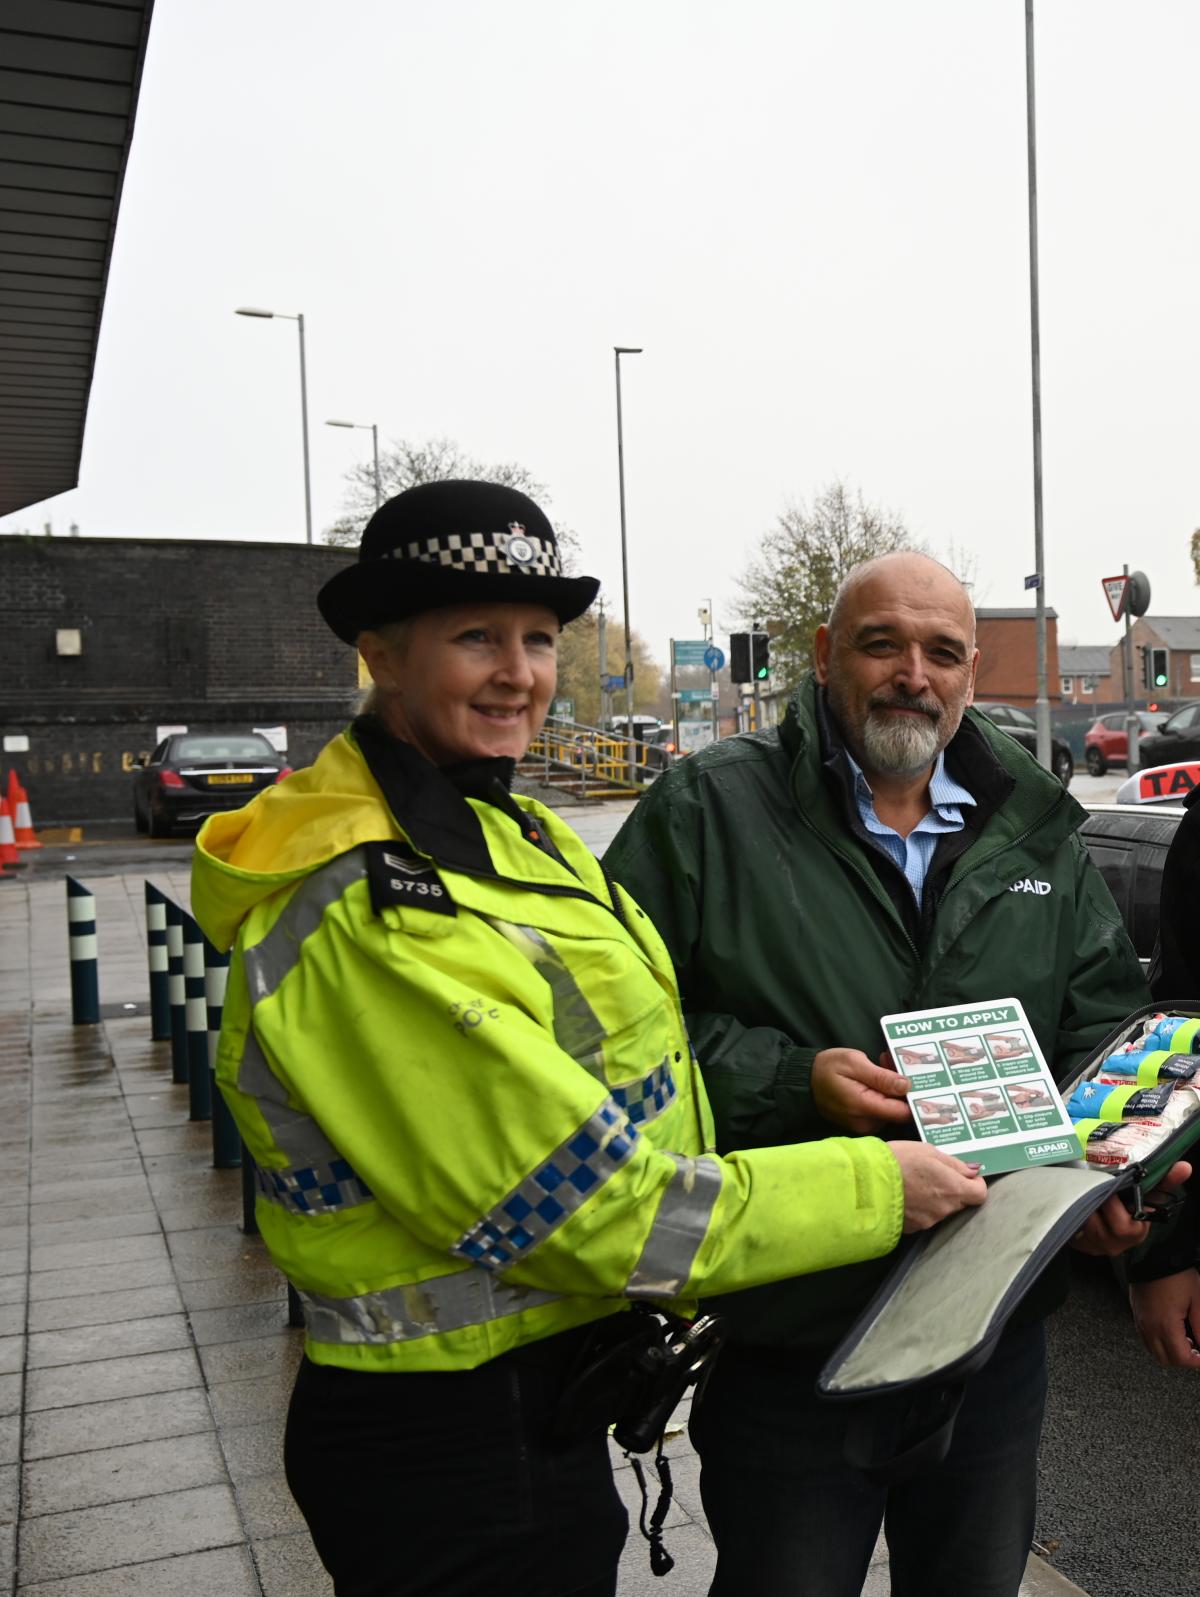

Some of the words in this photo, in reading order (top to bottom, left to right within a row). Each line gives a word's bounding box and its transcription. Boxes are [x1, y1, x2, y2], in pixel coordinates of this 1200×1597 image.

[390, 878, 443, 897] 5735
[1008, 878, 1052, 896] PAID
[894, 1021, 932, 1036] HOW
[936, 1018, 958, 1028] TO
[962, 1010, 1009, 1026] APPLY
[1028, 1142, 1068, 1155] RAPAID
